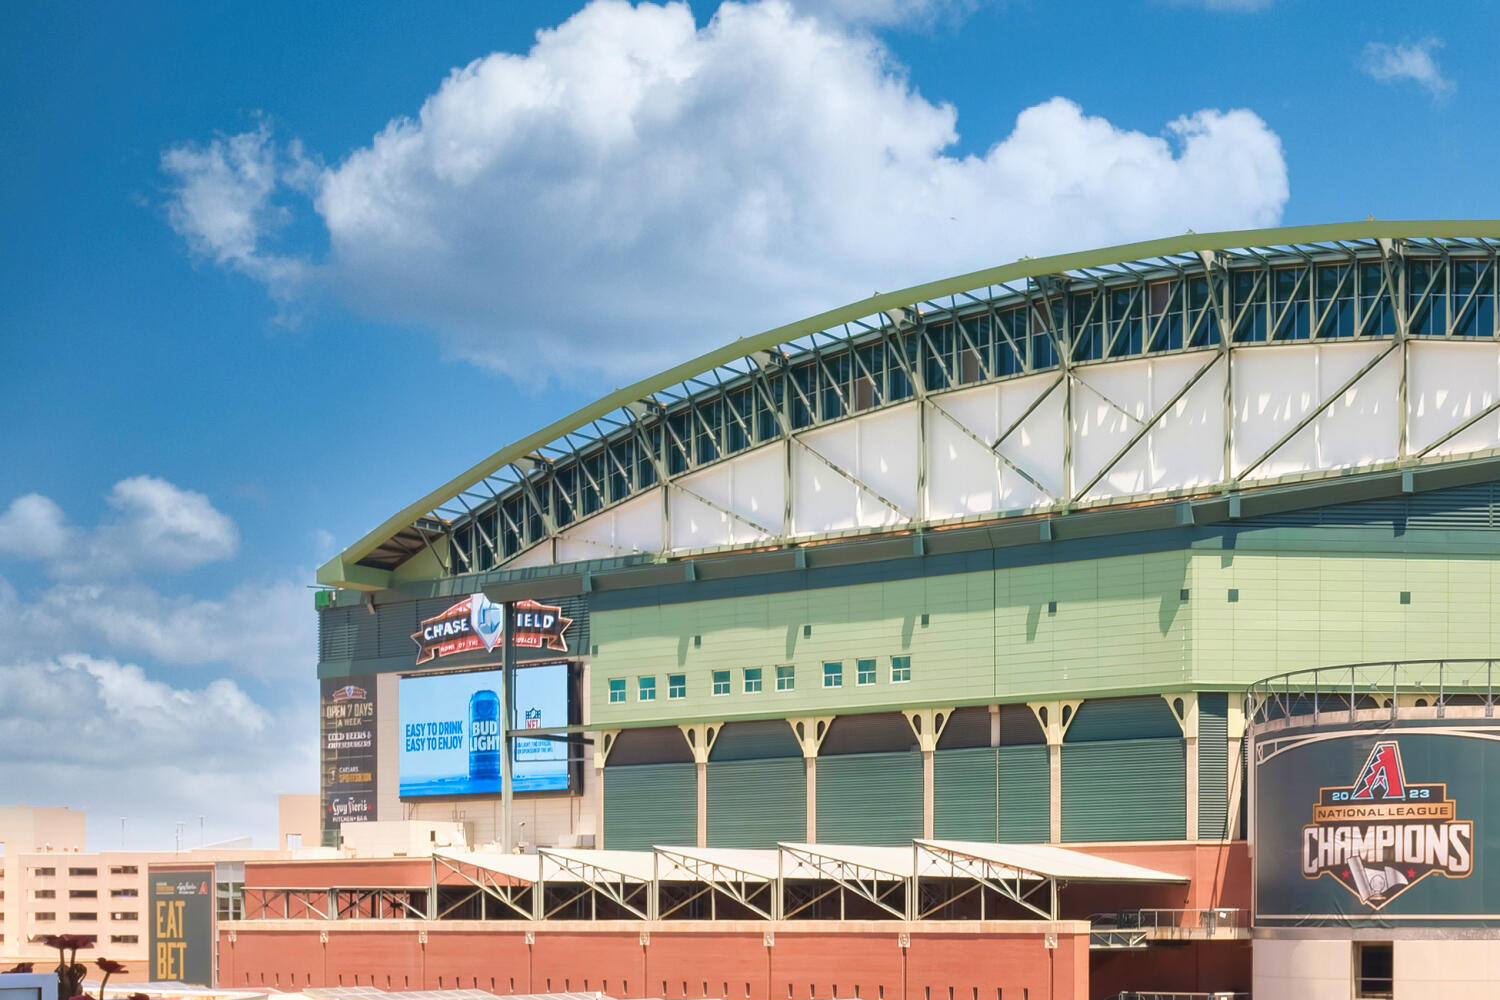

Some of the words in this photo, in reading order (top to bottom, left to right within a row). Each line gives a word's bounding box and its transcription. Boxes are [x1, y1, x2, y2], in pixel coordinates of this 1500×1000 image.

[424, 617, 469, 640] CHASE
[514, 613, 555, 629] IELD
[326, 704, 346, 719] OPEN
[347, 703, 353, 717] 7
[354, 702, 373, 717] DAYS
[406, 722, 425, 737] EASY
[427, 721, 438, 735] TO
[438, 720, 463, 735] DRINK
[472, 720, 497, 736] BUD
[406, 737, 425, 752] EASY
[427, 737, 438, 750] TO
[438, 735, 463, 750] ENJOY
[1332, 791, 1350, 801] 20
[1409, 789, 1430, 799] 23
[332, 798, 348, 816] Guy
[1317, 807, 1385, 819] NATIONAL
[1388, 806, 1449, 817] LEAGUE
[1303, 824, 1471, 874] CHAMPIONS
[156, 900, 186, 938] EAT
[156, 941, 187, 980] BET
